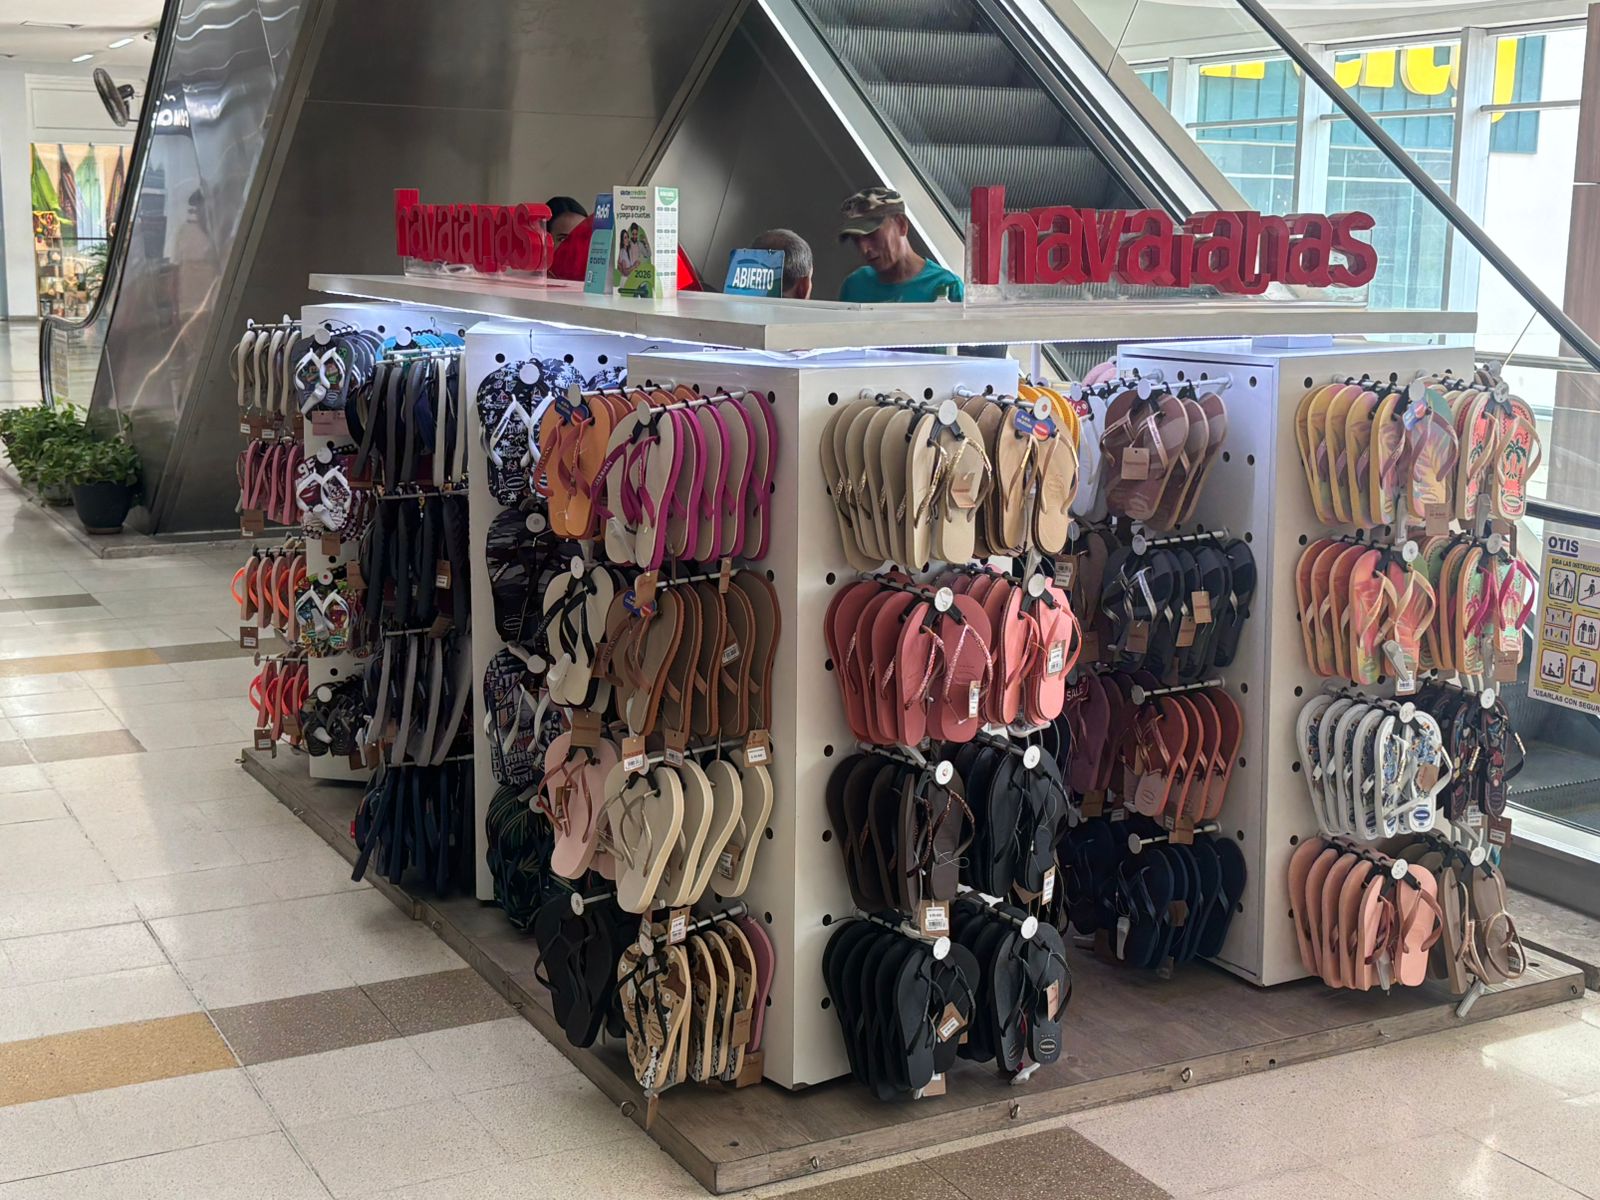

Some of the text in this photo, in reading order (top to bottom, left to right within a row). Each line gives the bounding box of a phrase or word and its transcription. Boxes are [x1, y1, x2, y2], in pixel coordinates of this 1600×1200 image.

[620, 203, 639, 212] Compra
[619, 212, 631, 220] paga
[394, 188, 554, 273] havaianas
[971, 184, 1379, 295] havaianas
[635, 270, 652, 279] 2026
[732, 267, 774, 291] ABIERTO
[1548, 536, 1579, 553] OTIS
[1066, 684, 1083, 700] SALE
[1564, 697, 1578, 707] CON
